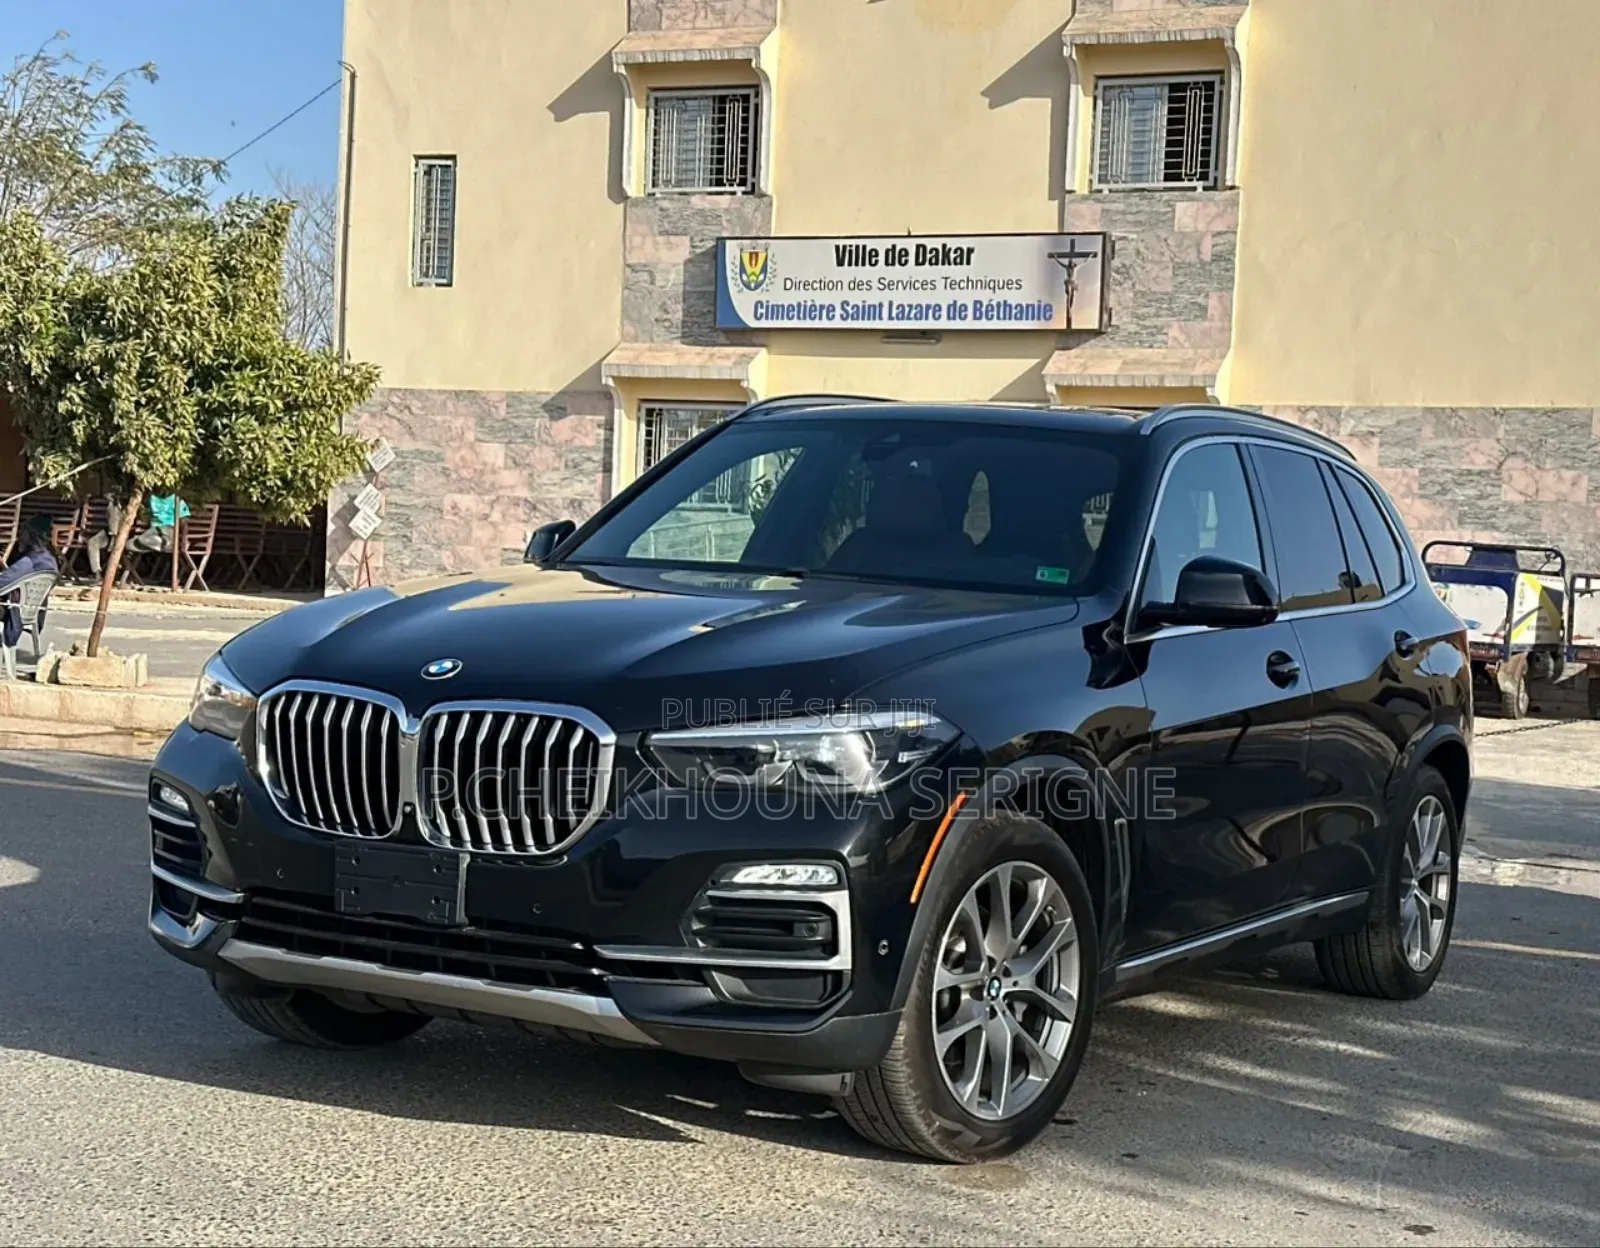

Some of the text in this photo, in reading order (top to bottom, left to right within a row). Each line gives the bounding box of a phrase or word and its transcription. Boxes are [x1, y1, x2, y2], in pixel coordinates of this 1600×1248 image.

[835, 242, 974, 267] Ville de Dakar
[783, 274, 1023, 294] Direction des Services Techniques
[753, 299, 1053, 322] Cimetière Saint Lazare de Béthanie
